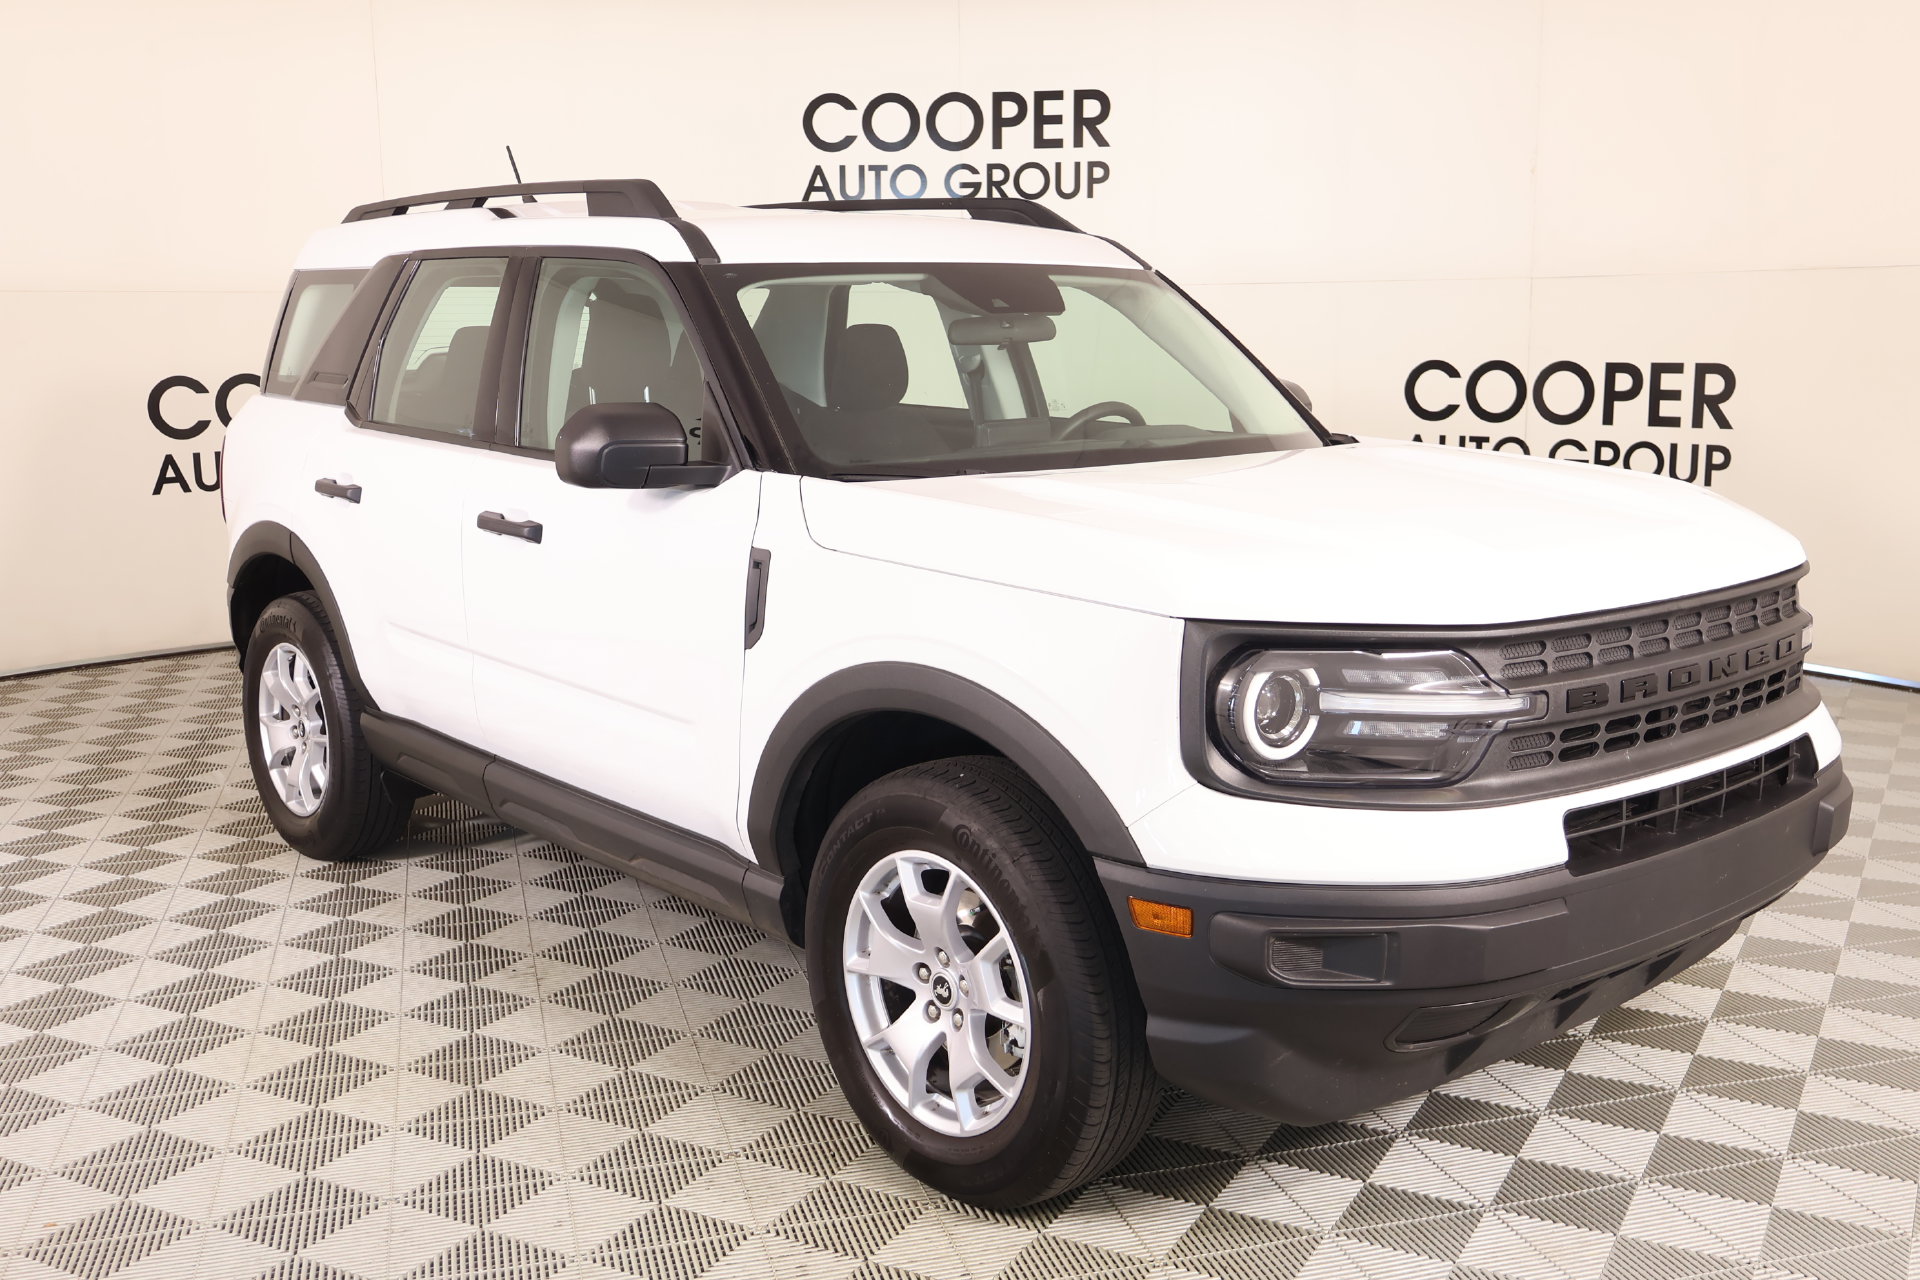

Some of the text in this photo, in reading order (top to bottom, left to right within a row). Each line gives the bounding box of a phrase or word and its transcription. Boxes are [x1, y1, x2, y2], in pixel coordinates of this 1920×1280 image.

[802, 89, 1111, 152] COOPER
[802, 161, 1110, 201] AUTO GROUP
[1404, 359, 1736, 430] COOPER
[1565, 632, 1801, 714] BRONCO
